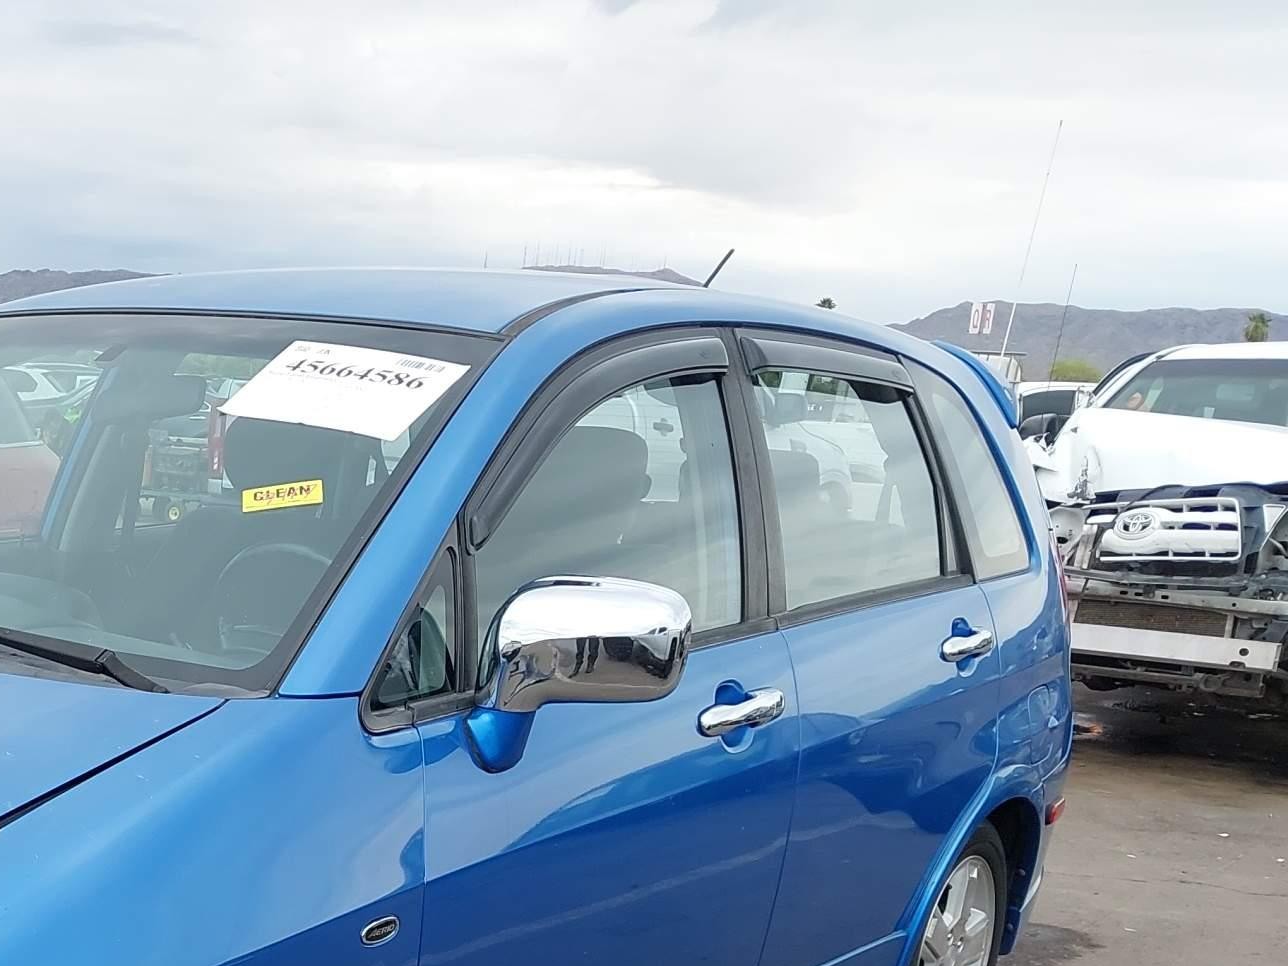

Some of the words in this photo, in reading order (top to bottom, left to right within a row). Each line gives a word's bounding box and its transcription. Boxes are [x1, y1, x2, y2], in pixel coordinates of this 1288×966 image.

[285, 358, 428, 389] 45664586
[253, 484, 312, 502] CLEAN
[367, 924, 395, 938] AERIO
